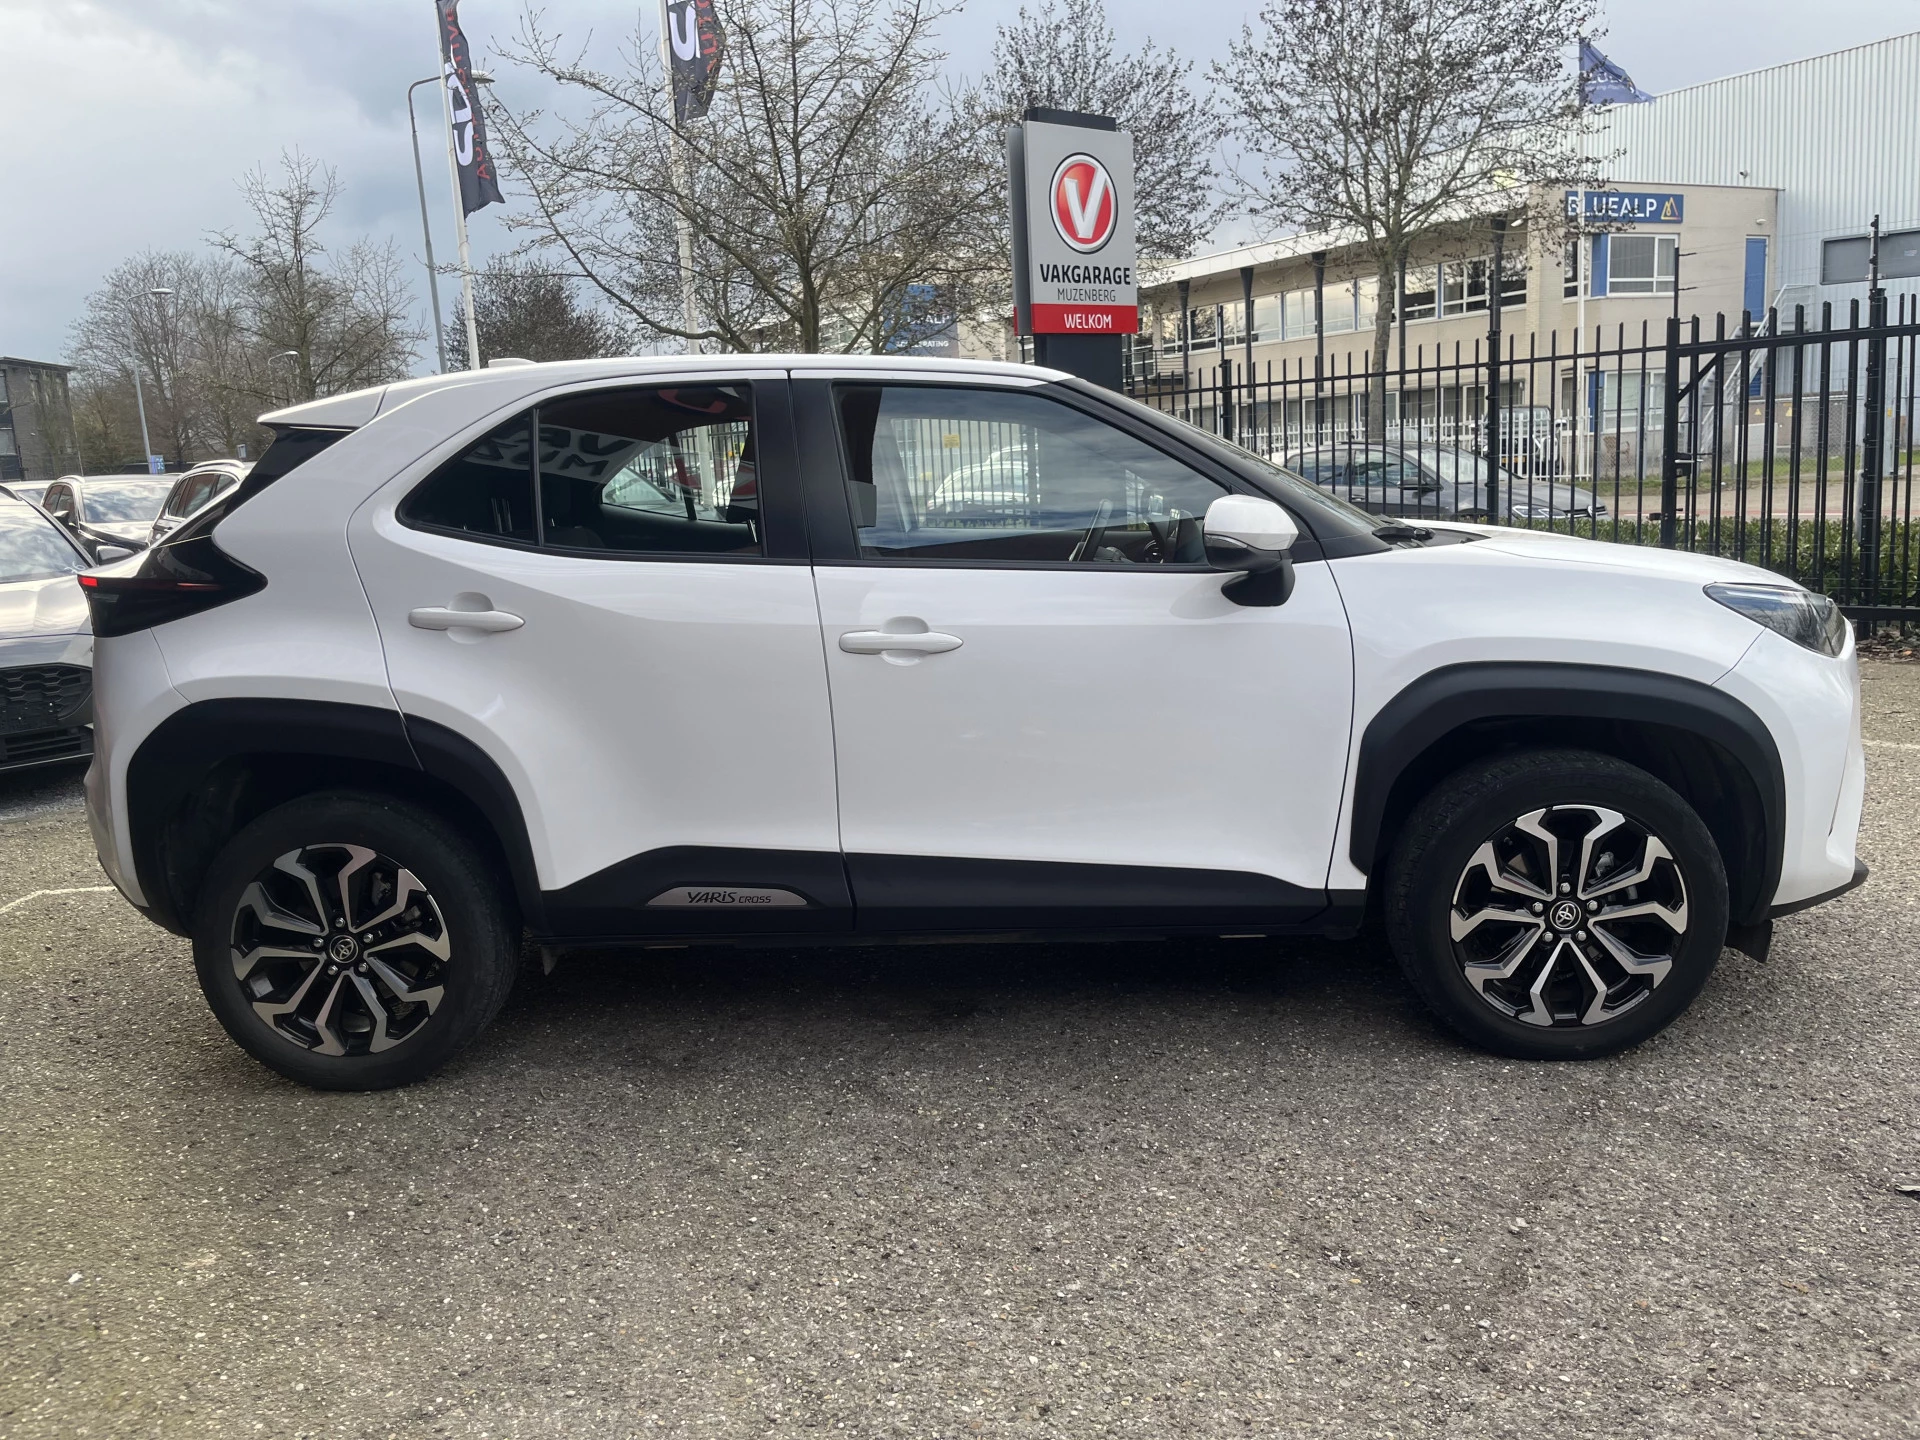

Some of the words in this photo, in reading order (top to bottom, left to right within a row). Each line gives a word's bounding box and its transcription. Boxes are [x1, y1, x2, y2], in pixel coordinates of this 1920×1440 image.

[1040, 263, 1131, 285] VAKGARAGE
[1057, 288, 1116, 302] MUZENBERG
[1063, 313, 1112, 329] WELKOM
[738, 895, 772, 904] CROSS
